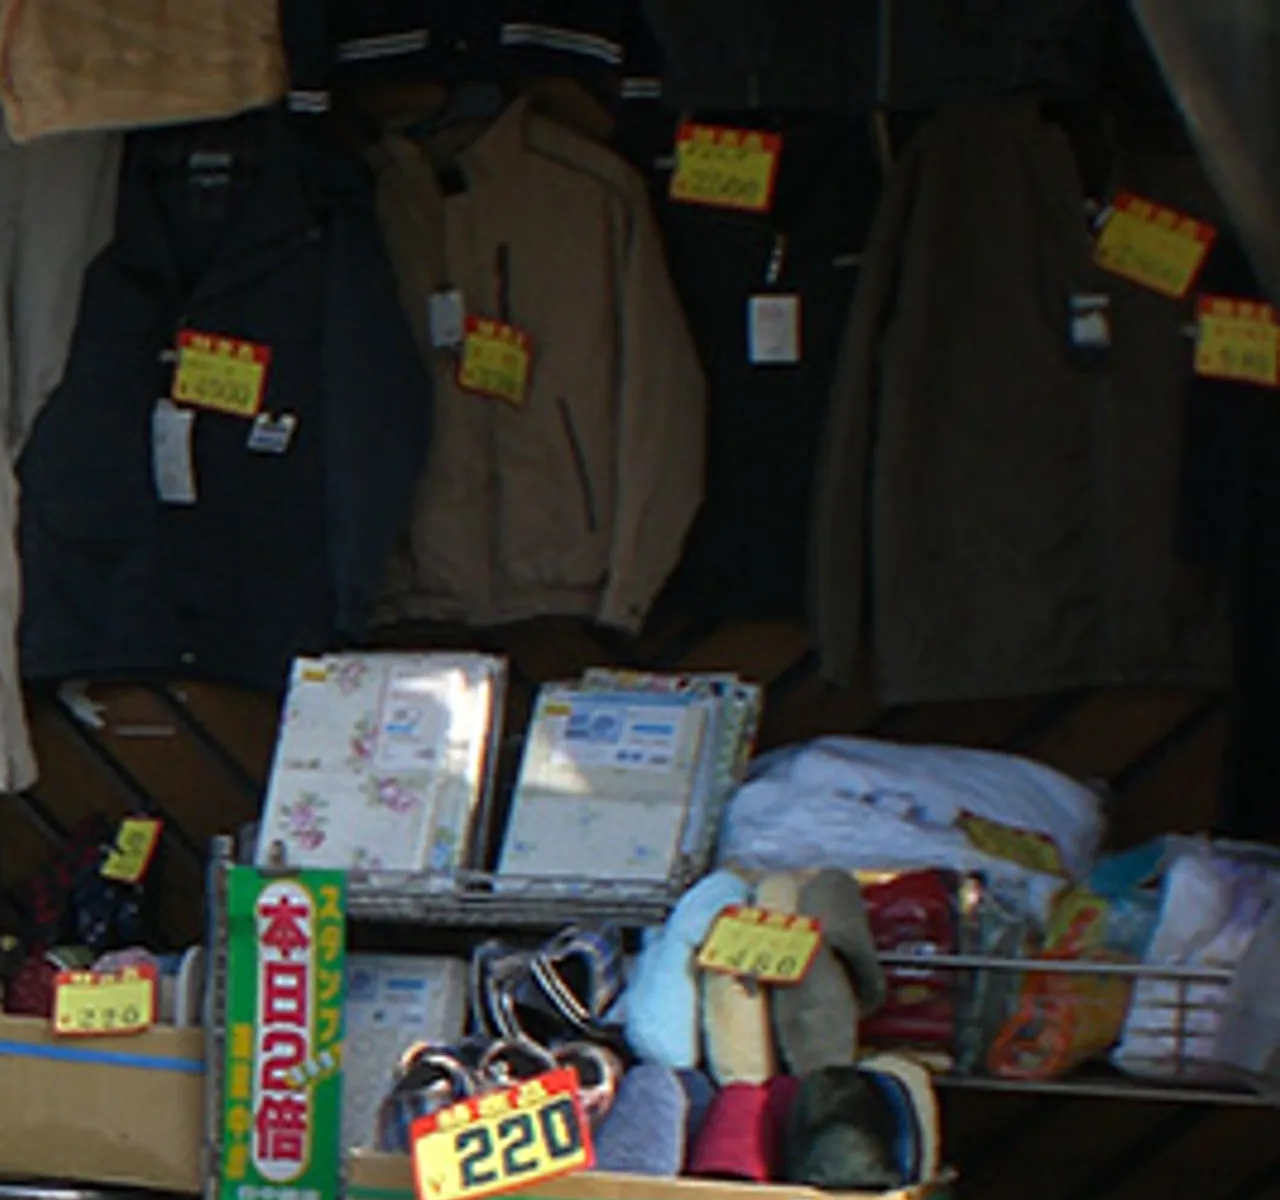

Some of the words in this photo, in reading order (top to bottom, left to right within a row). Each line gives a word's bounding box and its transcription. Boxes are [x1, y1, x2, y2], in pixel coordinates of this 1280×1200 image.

[254, 895, 311, 1163] 本日2倍
[455, 1098, 581, 1190] 220
